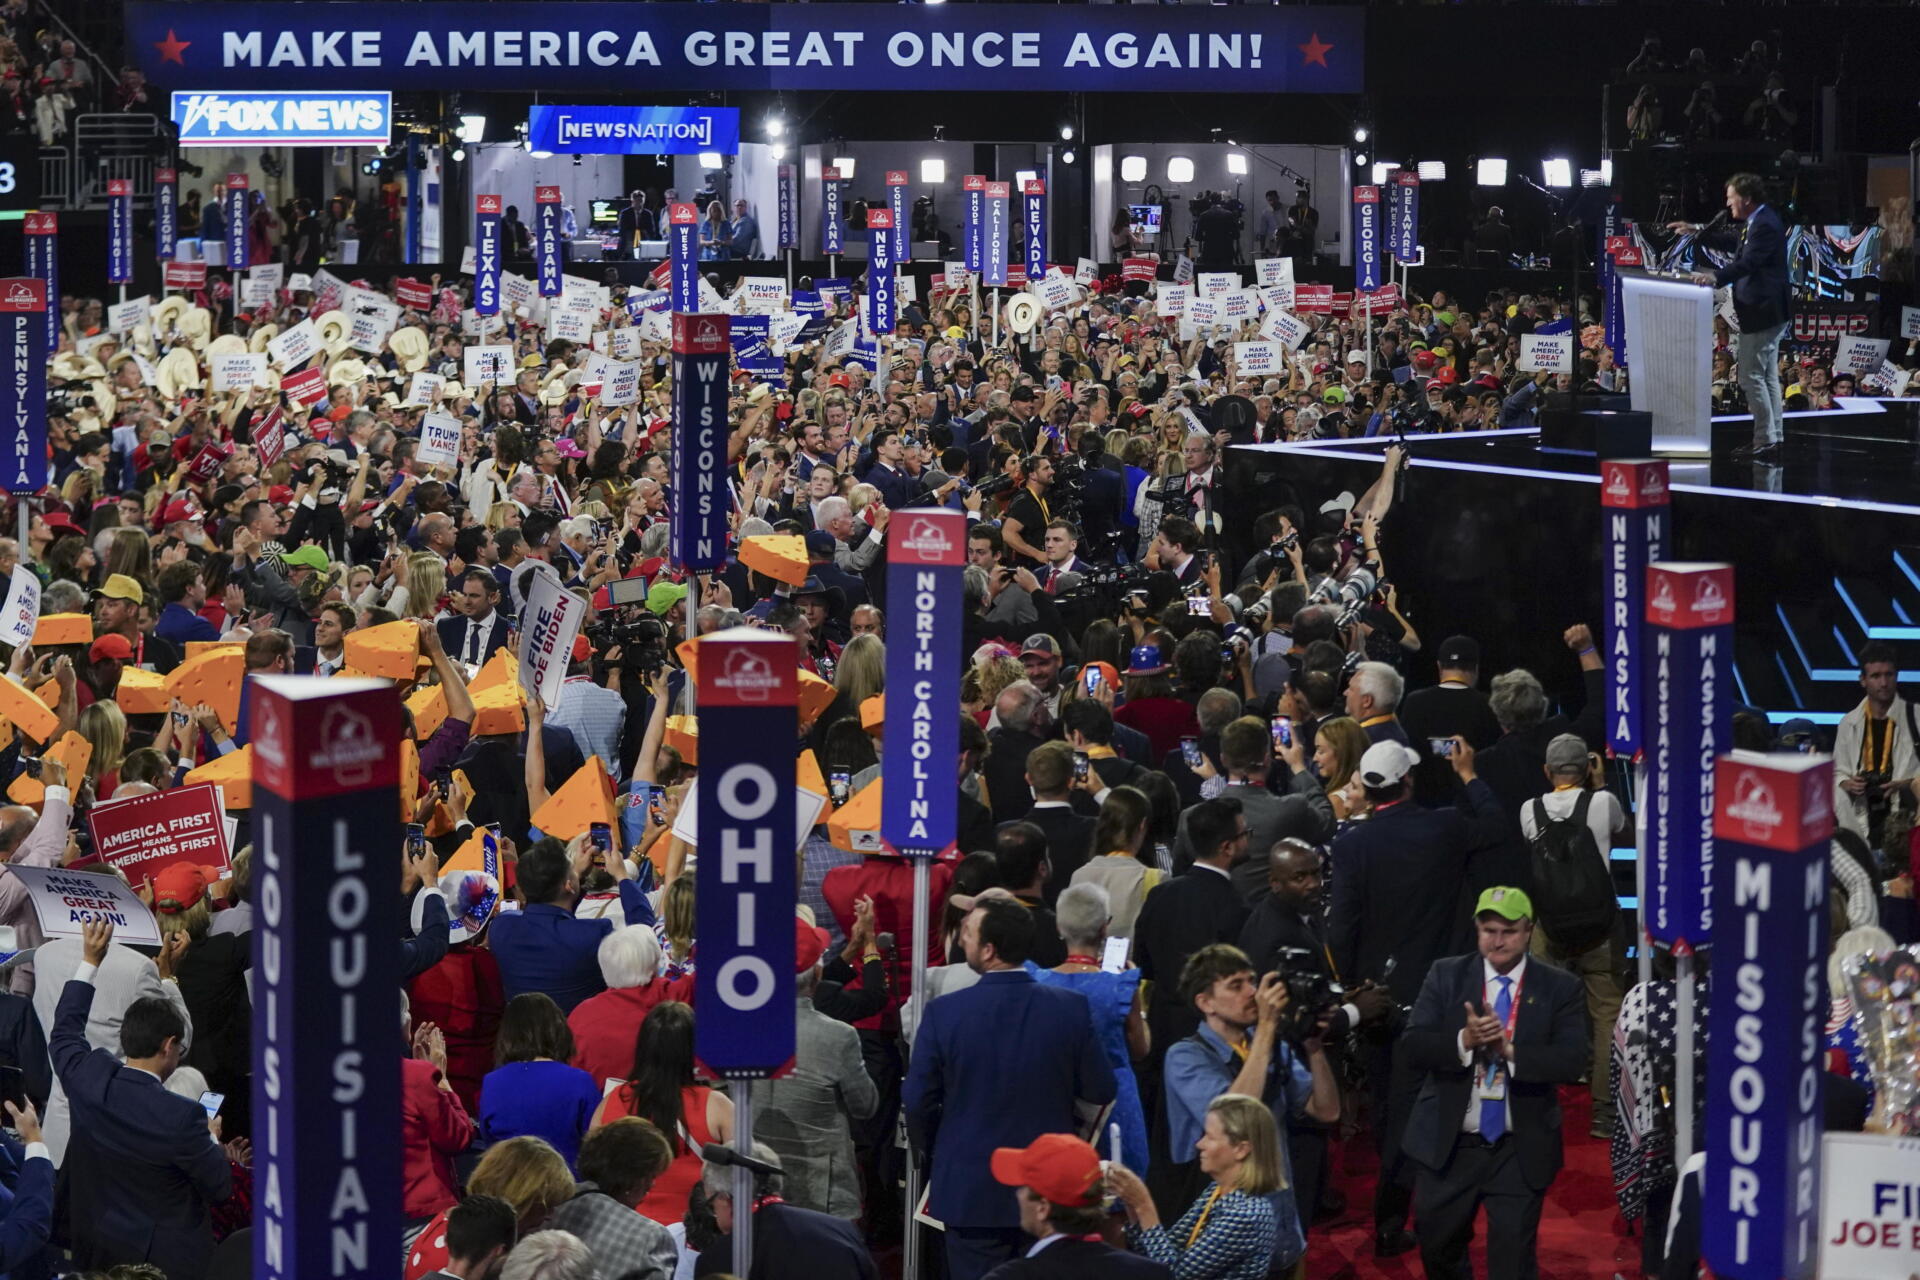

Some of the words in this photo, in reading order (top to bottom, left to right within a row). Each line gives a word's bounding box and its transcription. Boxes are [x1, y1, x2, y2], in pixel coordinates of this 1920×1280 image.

[223, 31, 382, 67] MAKE
[404, 31, 662, 67] AMERICA
[684, 31, 864, 67] GREAT
[887, 32, 1041, 68] ONCE
[1064, 33, 1263, 69] AGAIN!
[208, 100, 279, 132] FOX
[283, 100, 383, 131] NEWS
[161, 185, 172, 254] ARIZONA
[234, 191, 243, 265] ARKANSAS
[827, 183, 838, 249] MONTANA
[894, 186, 904, 259] CONNECTICUT
[971, 192, 979, 226] RHODE
[1389, 206, 1399, 248] MEXICO
[1402, 188, 1413, 257] DELAWARE
[113, 198, 121, 277] ILLINOIS
[543, 205, 556, 291] ALABAMA
[680, 226, 689, 260] WEST
[875, 231, 888, 269] NEW
[991, 200, 1001, 281] CALIFORNIA
[1030, 198, 1041, 274] NEVADA
[1361, 204, 1374, 287] GEORGIA
[480, 221, 495, 306] TEXAS
[630, 296, 666, 310] TRUMP
[748, 284, 783, 292] TRUMP
[876, 276, 888, 329] YORK
[1274, 320, 1299, 337] AMERICA
[1275, 326, 1294, 339] GREAT
[1281, 317, 1299, 329] MAKE
[1847, 349, 1879, 358] AMERICA
[1855, 343, 1876, 351] MAKE
[612, 375, 636, 385] AMERICA
[615, 383, 633, 391] GREAT
[619, 368, 634, 376] MAKE
[14, 316, 29, 484] PENNSYLVANIA
[427, 426, 459, 441] TRUMP
[430, 438, 456, 452] VANCE
[672, 360, 683, 558] WISCONSIN
[697, 362, 719, 559] WISCONSIN
[527, 605, 552, 670] FIRE
[532, 656, 549, 696] JOE
[542, 594, 570, 655] BIDEN
[914, 571, 935, 672] NORTH
[1612, 514, 1631, 742] NEBRASKA
[909, 681, 933, 839] CAROLINA
[1657, 633, 1670, 929] MASSACHUSETTS
[1700, 634, 1716, 930] MASSACHUSETTS
[102, 822, 165, 849] AMERICA
[169, 811, 213, 832] FIRST
[108, 845, 179, 868] AMERICANS
[180, 835, 218, 852] FIRST
[141, 835, 173, 848] MEANS
[45, 883, 121, 900] AMERICA
[47, 875, 98, 889] MAKE
[63, 896, 118, 911] GREAT
[716, 763, 777, 1011] OHIO
[1729, 858, 1772, 1265] MISSOURI
[1796, 857, 1826, 1264] MISSOURI
[1830, 1219, 1901, 1248] JOE
